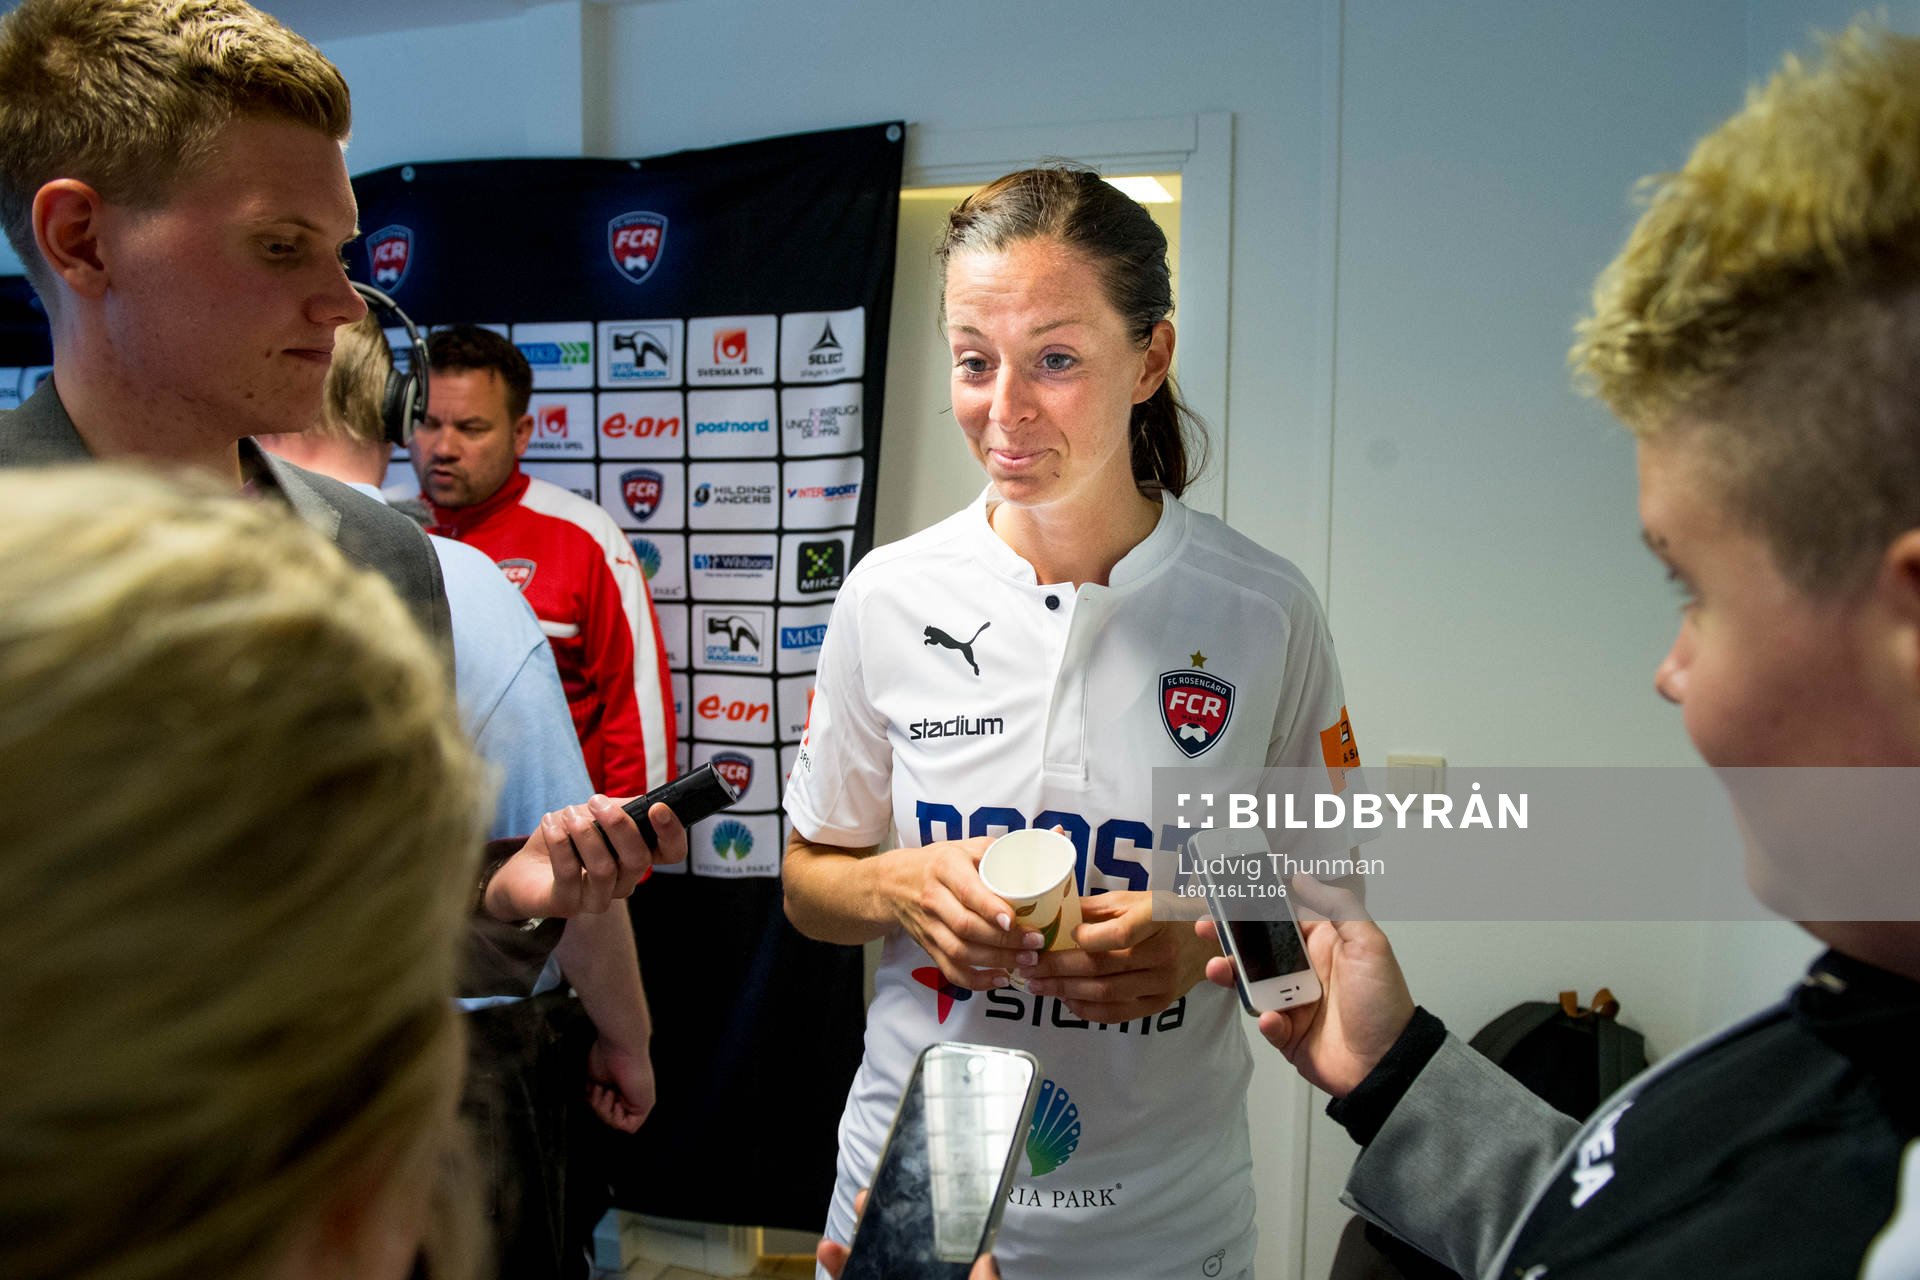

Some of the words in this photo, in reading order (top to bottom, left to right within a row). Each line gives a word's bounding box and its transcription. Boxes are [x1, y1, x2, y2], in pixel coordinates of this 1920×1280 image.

[615, 228, 659, 249] FCR
[808, 352, 843, 365] SELECT
[697, 368, 740, 377] SVENSKA
[743, 367, 764, 376] SPEL
[695, 419, 770, 436] postnord
[626, 482, 659, 498] FCR
[713, 485, 771, 495] HILDING
[713, 495, 772, 505] ANDERS
[1167, 678, 1178, 686] FC
[1179, 676, 1227, 695] ROSENGÅRD
[1169, 690, 1222, 718] FCR
[909, 714, 1004, 740] stadium
